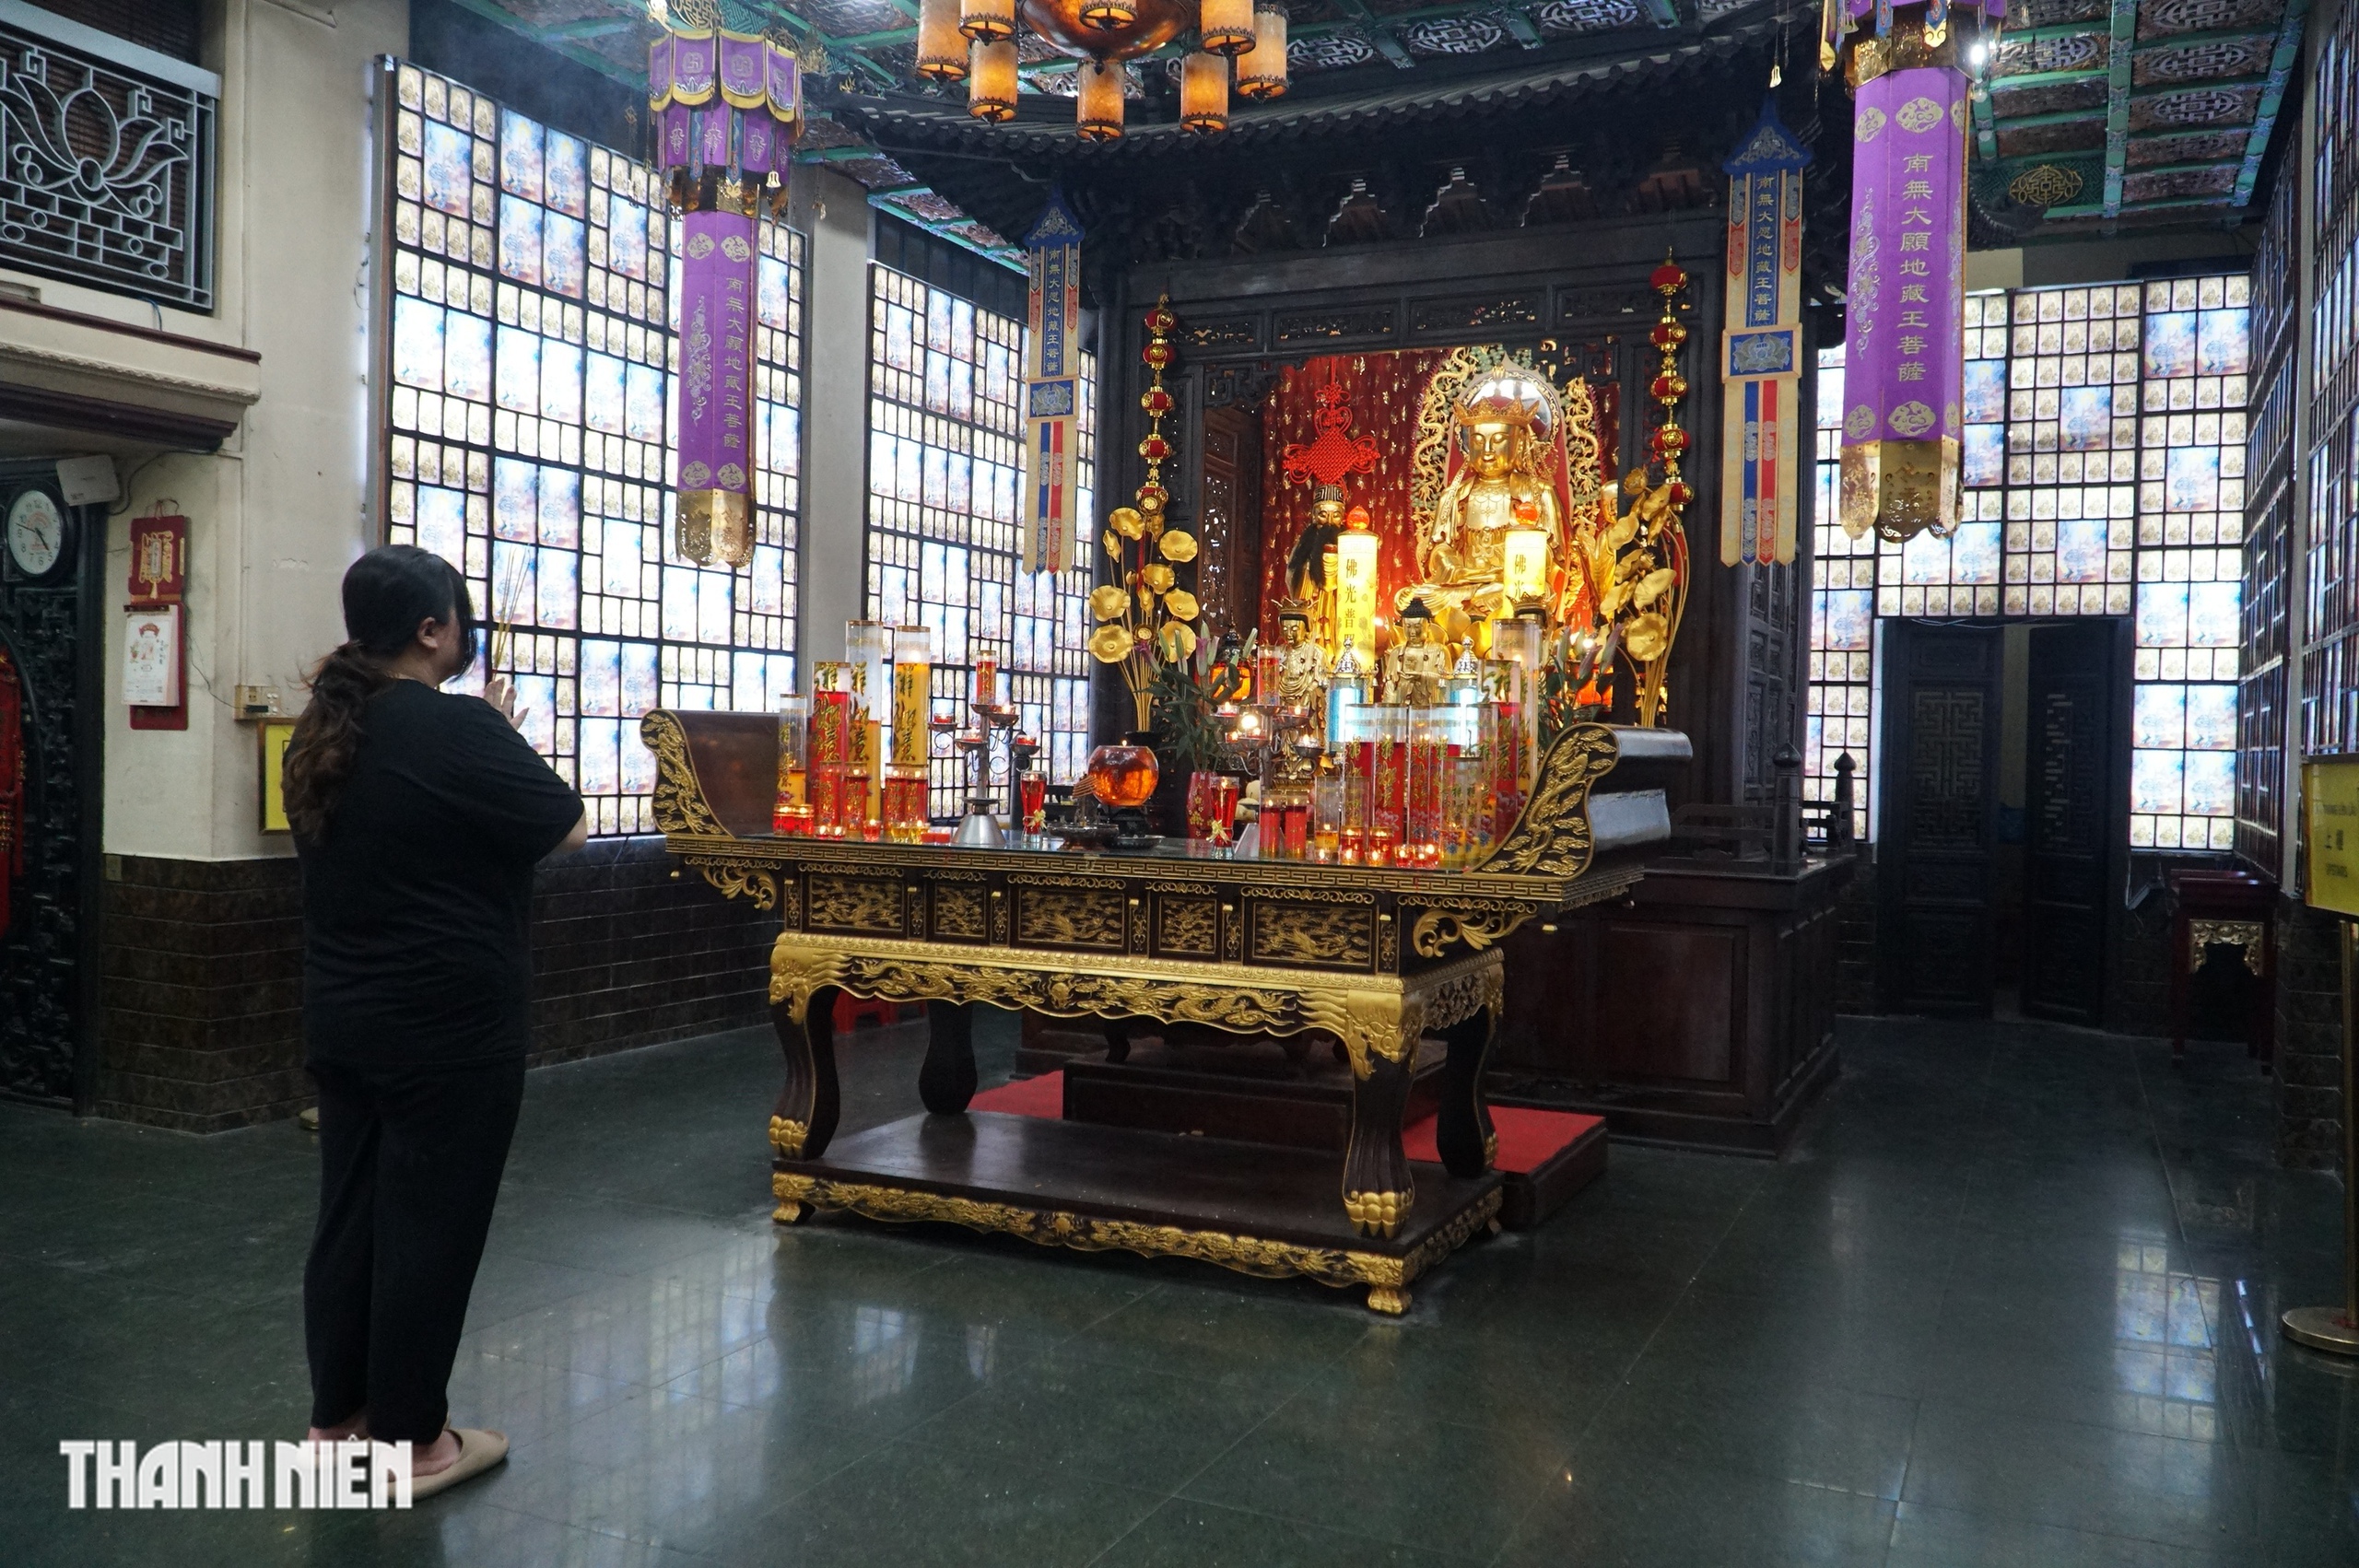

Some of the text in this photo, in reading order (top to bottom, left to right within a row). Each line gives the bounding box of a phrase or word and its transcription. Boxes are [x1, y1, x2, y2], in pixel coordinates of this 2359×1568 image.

[1895, 153, 1934, 382] 南無大願地藏王菩薩
